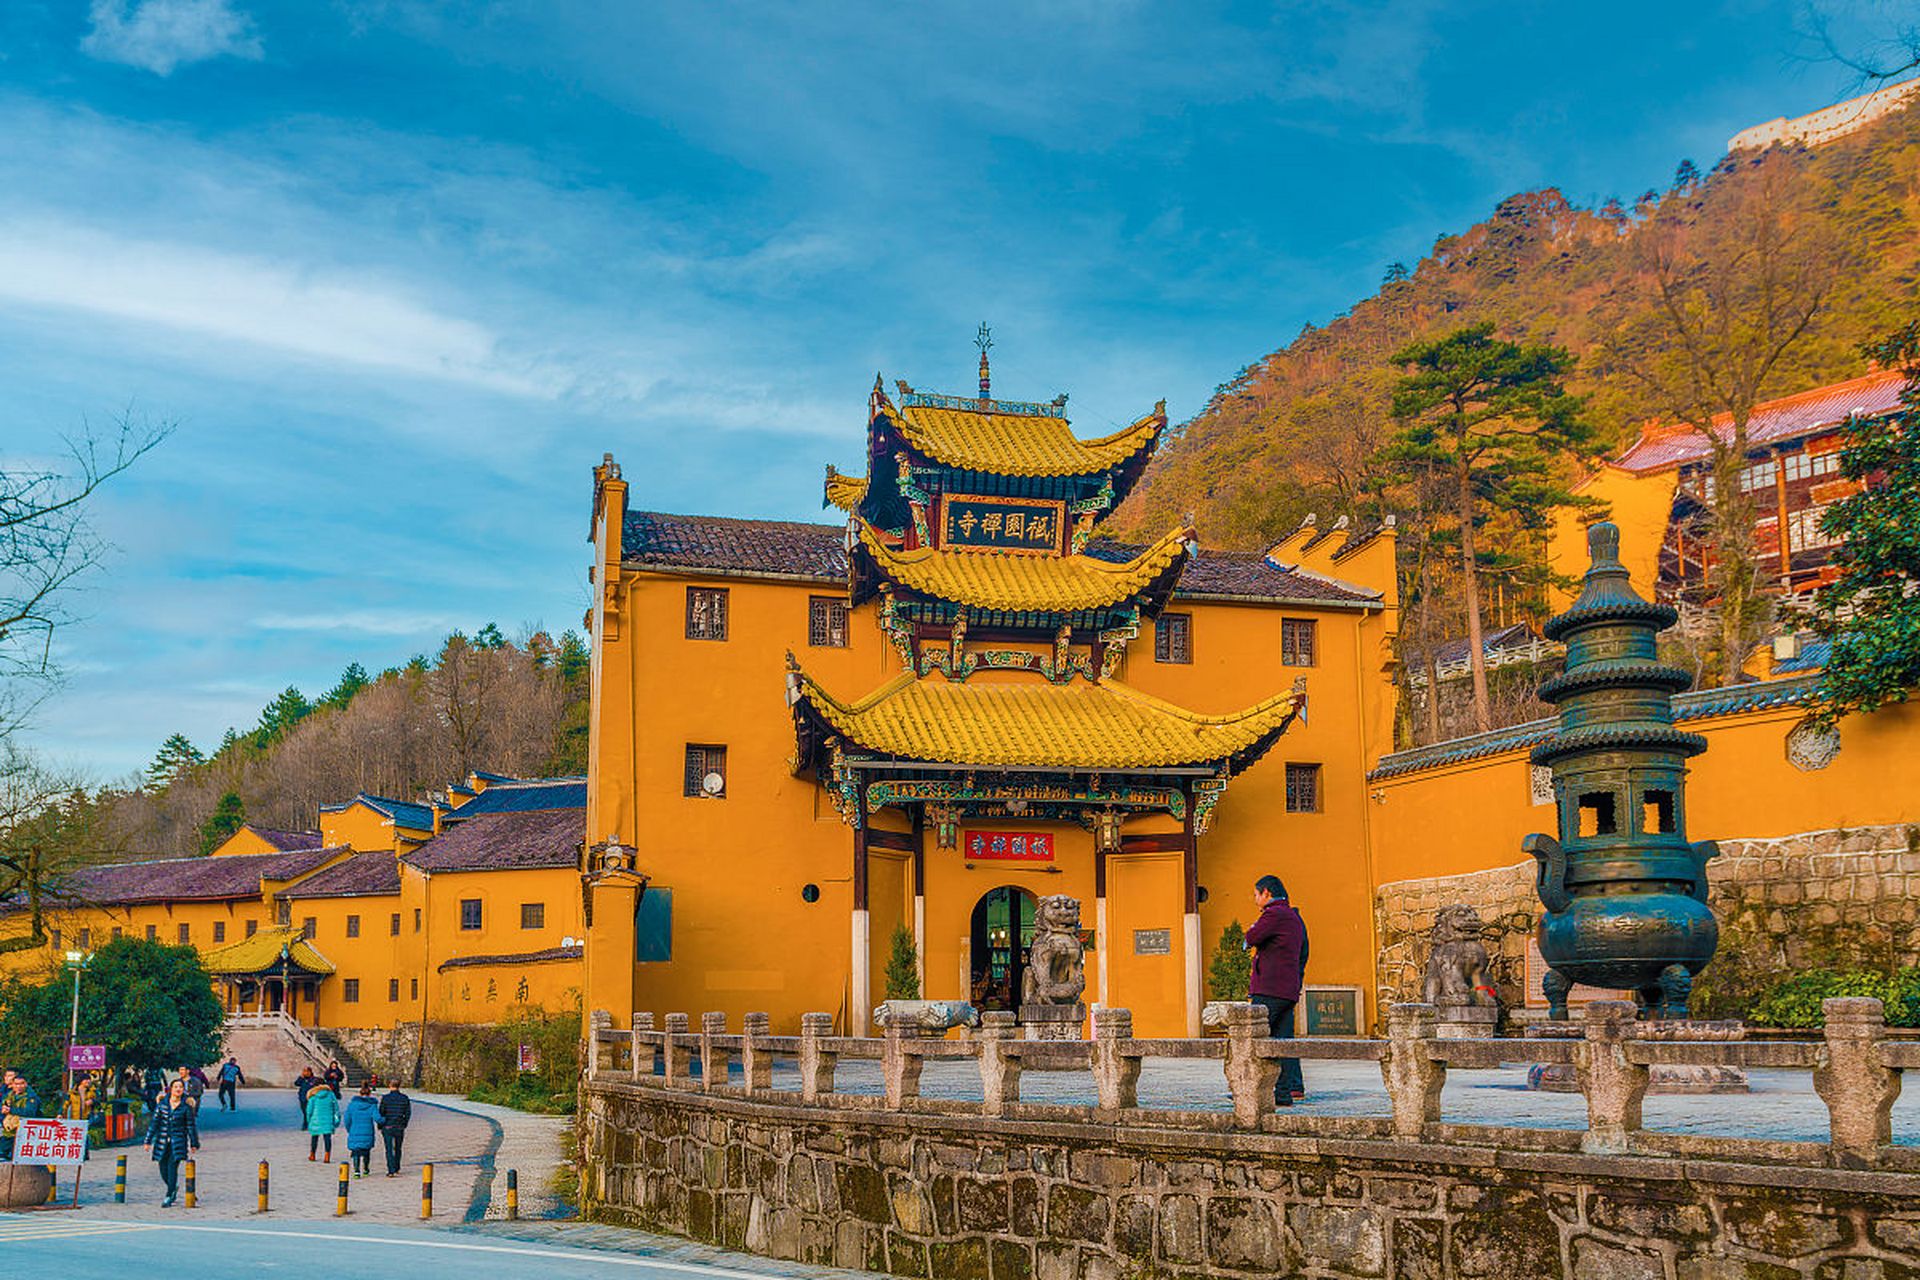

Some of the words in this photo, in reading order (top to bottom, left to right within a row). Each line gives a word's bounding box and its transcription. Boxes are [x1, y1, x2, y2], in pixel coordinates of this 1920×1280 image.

[23, 1126, 84, 1142] 下山乘车
[20, 1142, 82, 1159] 由此向前
